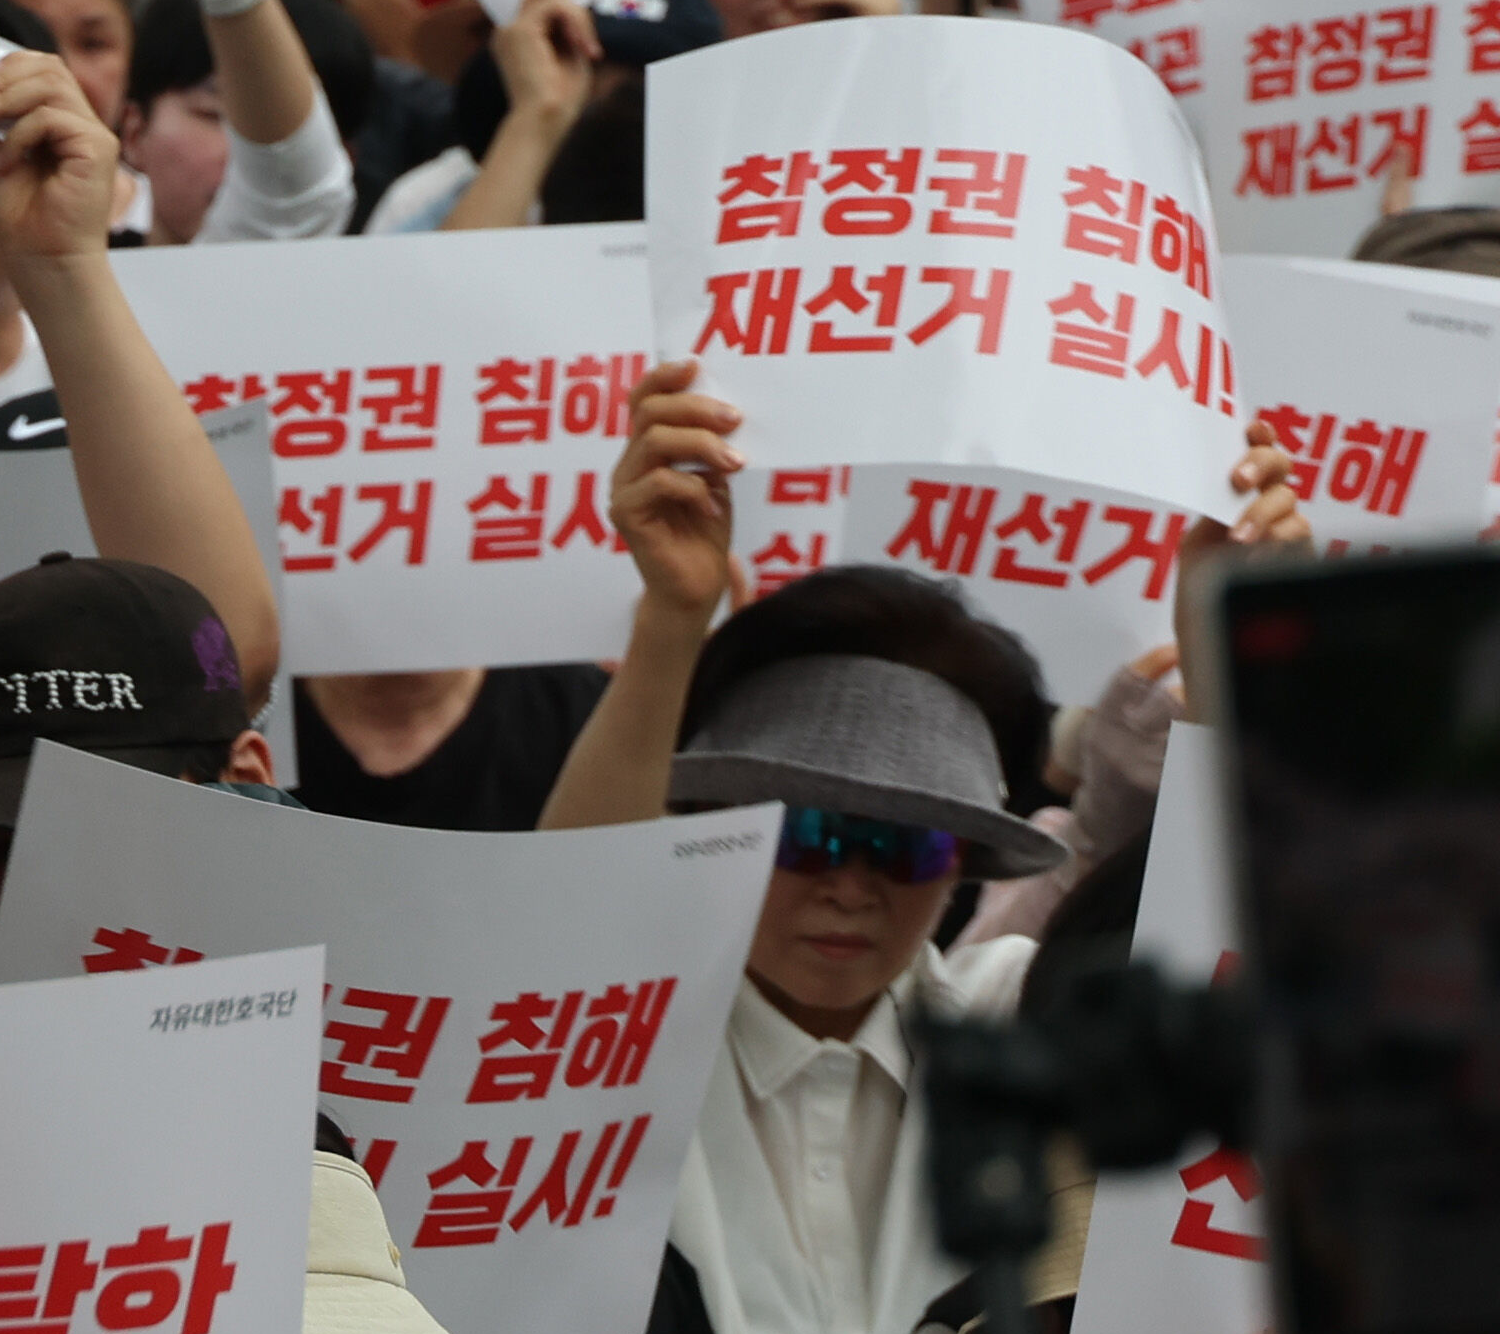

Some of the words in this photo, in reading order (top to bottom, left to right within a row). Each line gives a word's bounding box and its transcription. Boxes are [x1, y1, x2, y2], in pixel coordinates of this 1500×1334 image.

[1248, 6, 1436, 101] 참정권
[1239, 107, 1428, 196] 재선거
[717, 149, 1025, 243] 참정권
[1057, 167, 1210, 304] 침해
[695, 266, 1009, 355] 재선거
[1049, 280, 1234, 416] 실시!
[477, 355, 646, 445] 침해
[1254, 405, 1426, 516] 침해
[278, 481, 433, 572] 선거
[468, 473, 628, 561] 실시
[887, 481, 1188, 600] 재선거
[150, 990, 297, 1032] 자유대한호국단
[467, 978, 676, 1103] 침해
[414, 1116, 650, 1248] 실시!
